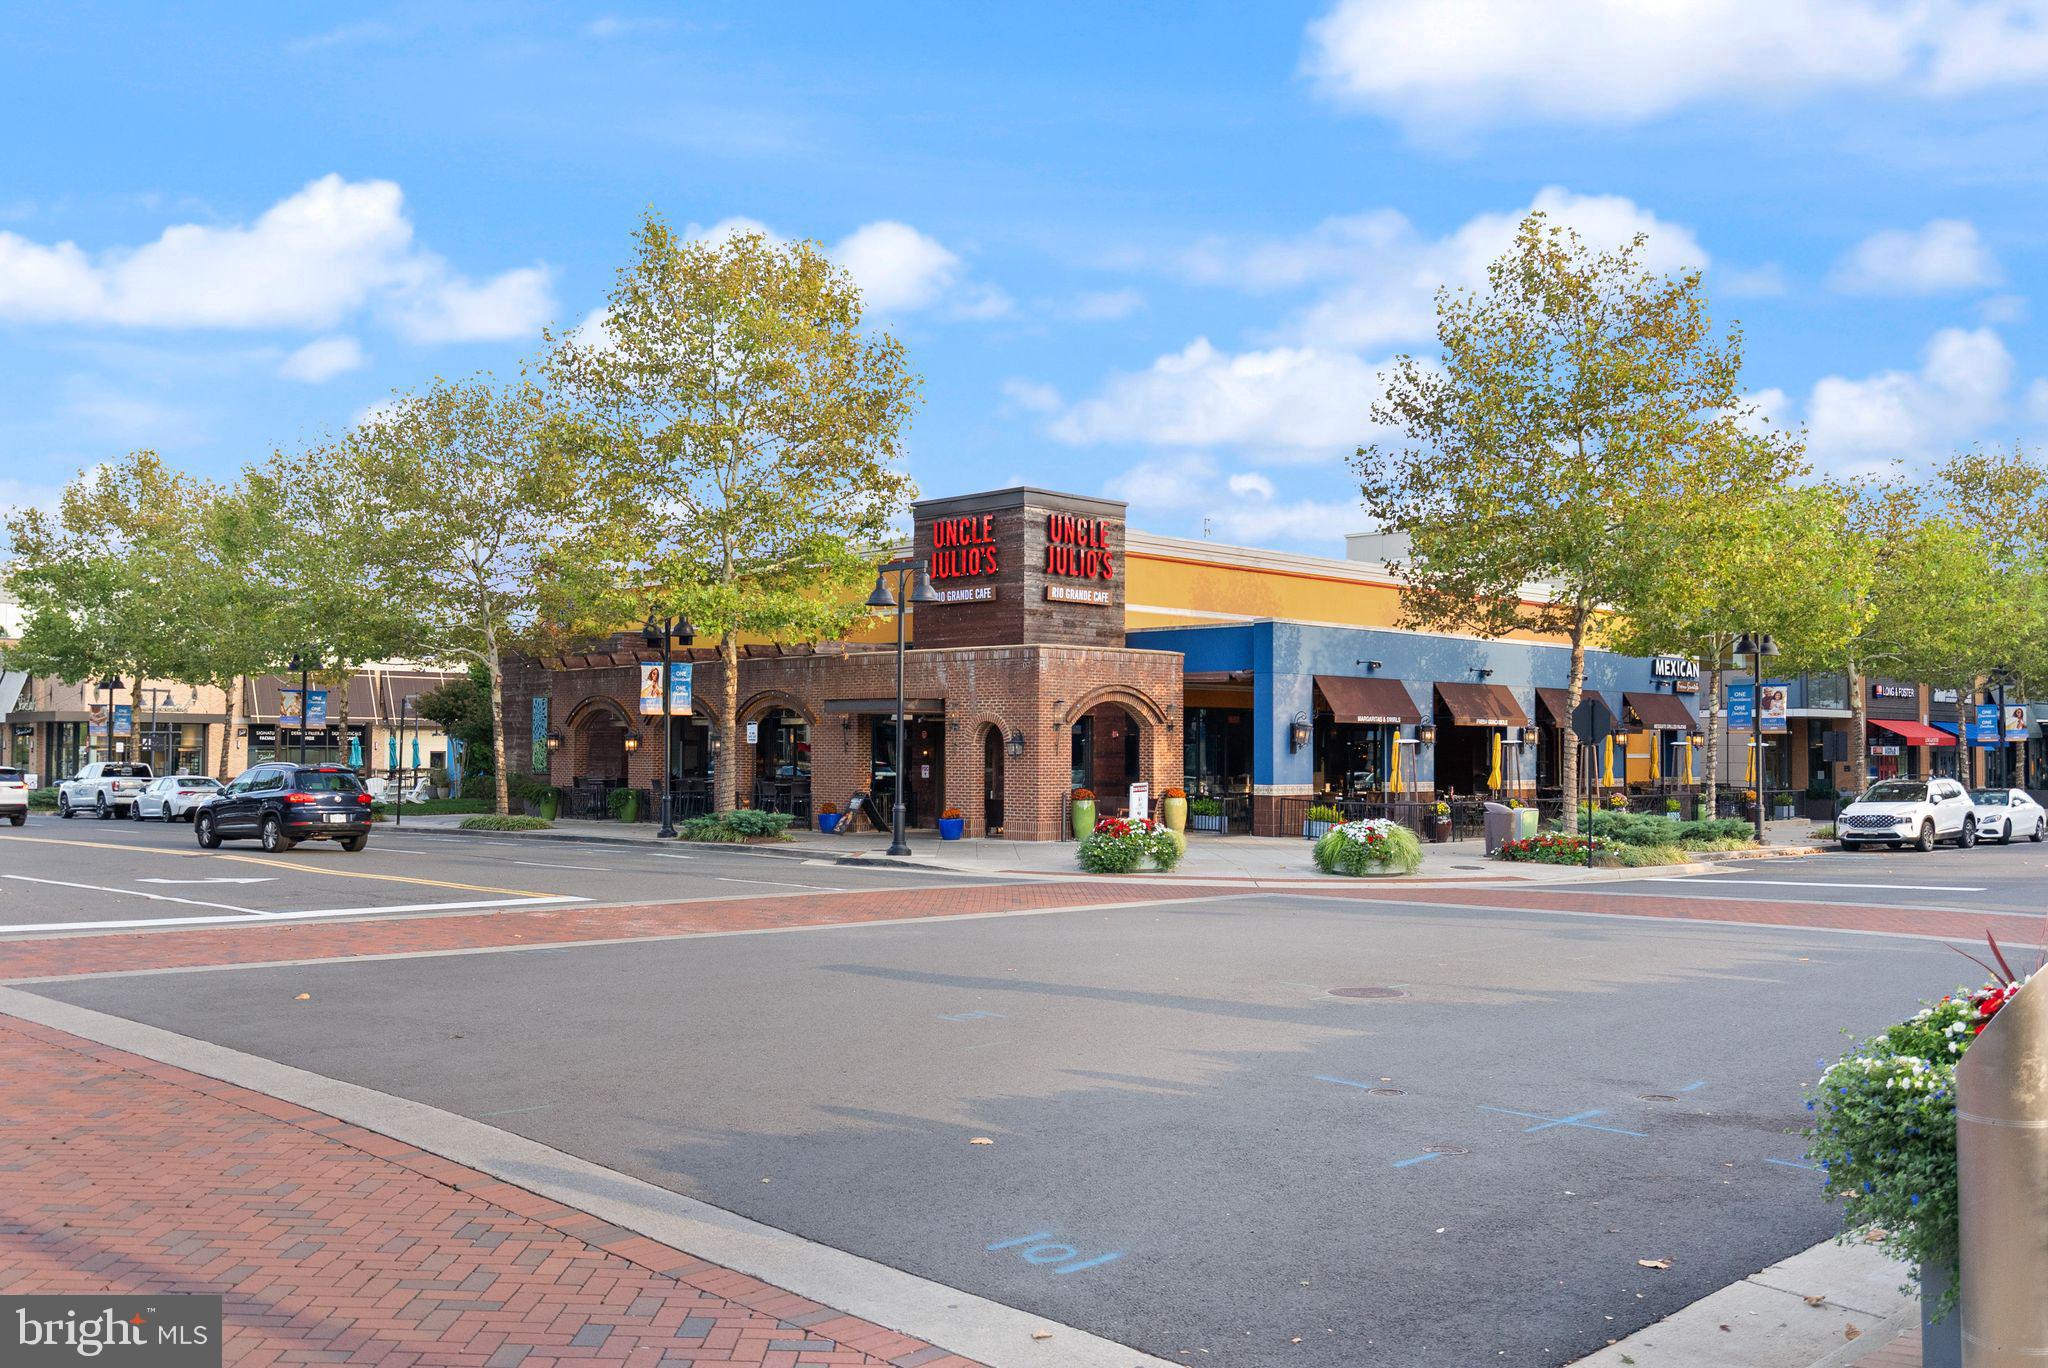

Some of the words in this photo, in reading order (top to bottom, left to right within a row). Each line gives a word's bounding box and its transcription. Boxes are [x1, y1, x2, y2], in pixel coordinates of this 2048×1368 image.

[933, 514, 993, 549] UNCLE
[1049, 512, 1110, 548] UNCLE
[930, 545, 997, 579] JULIO'S
[1046, 545, 1114, 580] JULIO'S
[947, 589, 974, 602] GRANDE
[975, 587, 992, 600] CAFE
[1051, 586, 1064, 599] RIO
[1065, 588, 1092, 602] GRANDE
[1093, 591, 1110, 603] CAFE
[1655, 659, 1700, 678] MEXICAN
[1883, 687, 1894, 696] LONG
[1895, 688, 1899, 697] &
[1899, 688, 1915, 698] FOSTER
